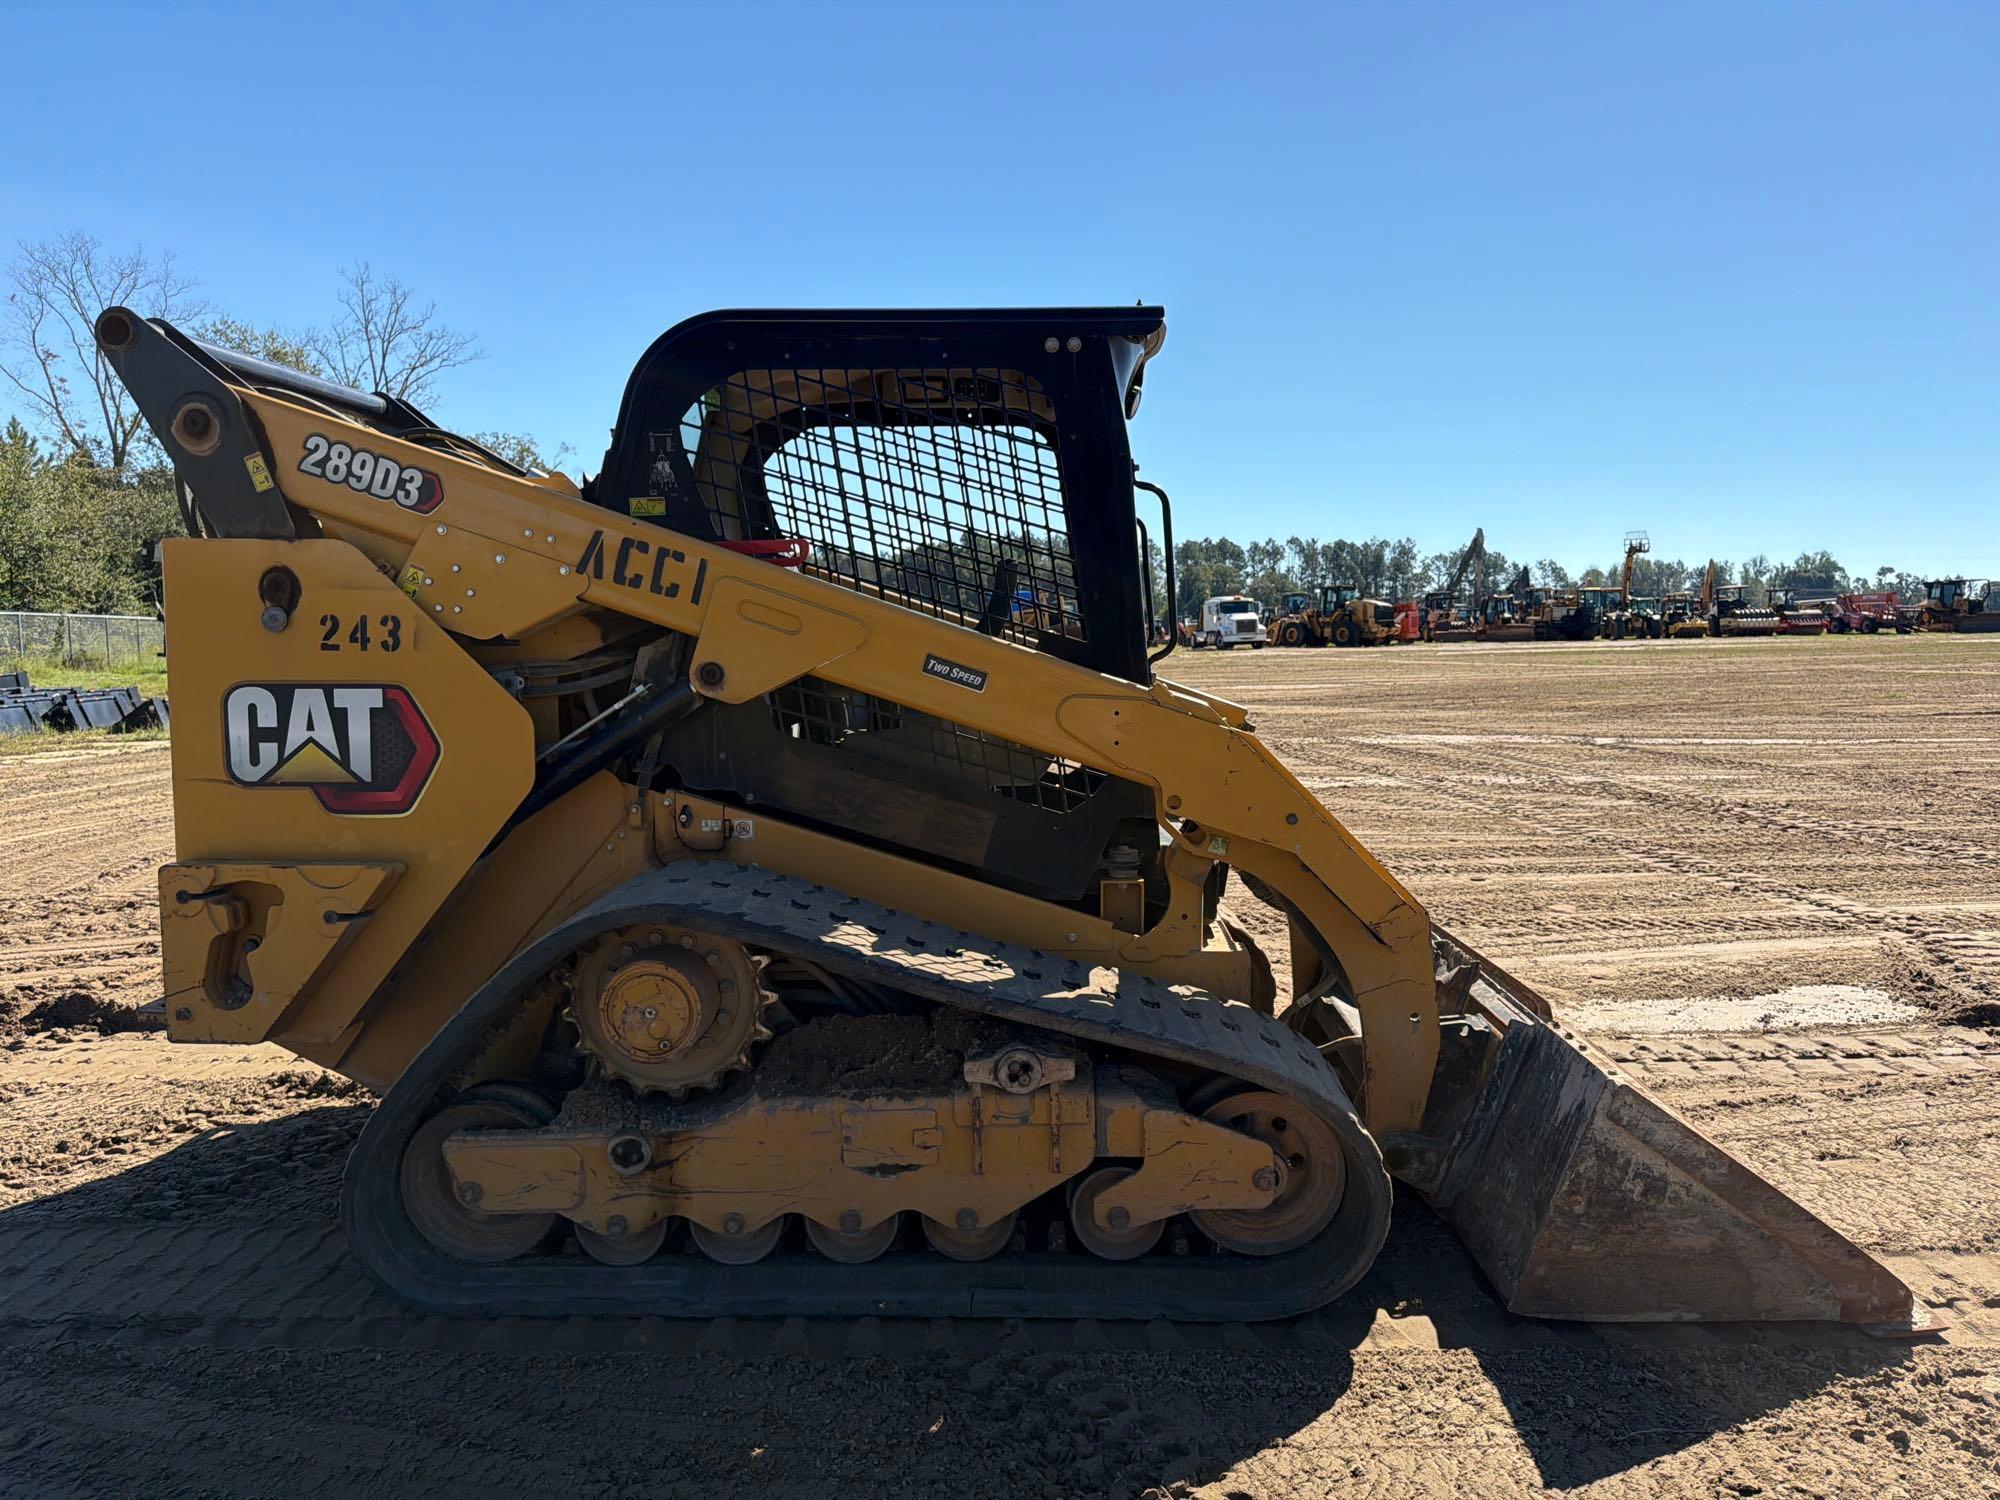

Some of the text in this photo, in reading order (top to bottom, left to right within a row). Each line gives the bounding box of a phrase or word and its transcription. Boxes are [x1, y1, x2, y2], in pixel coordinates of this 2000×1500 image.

[299, 436, 423, 506] 289D3
[319, 614, 402, 652] 243
[927, 659, 982, 686] TWO SPEED
[227, 686, 383, 783] CAT
